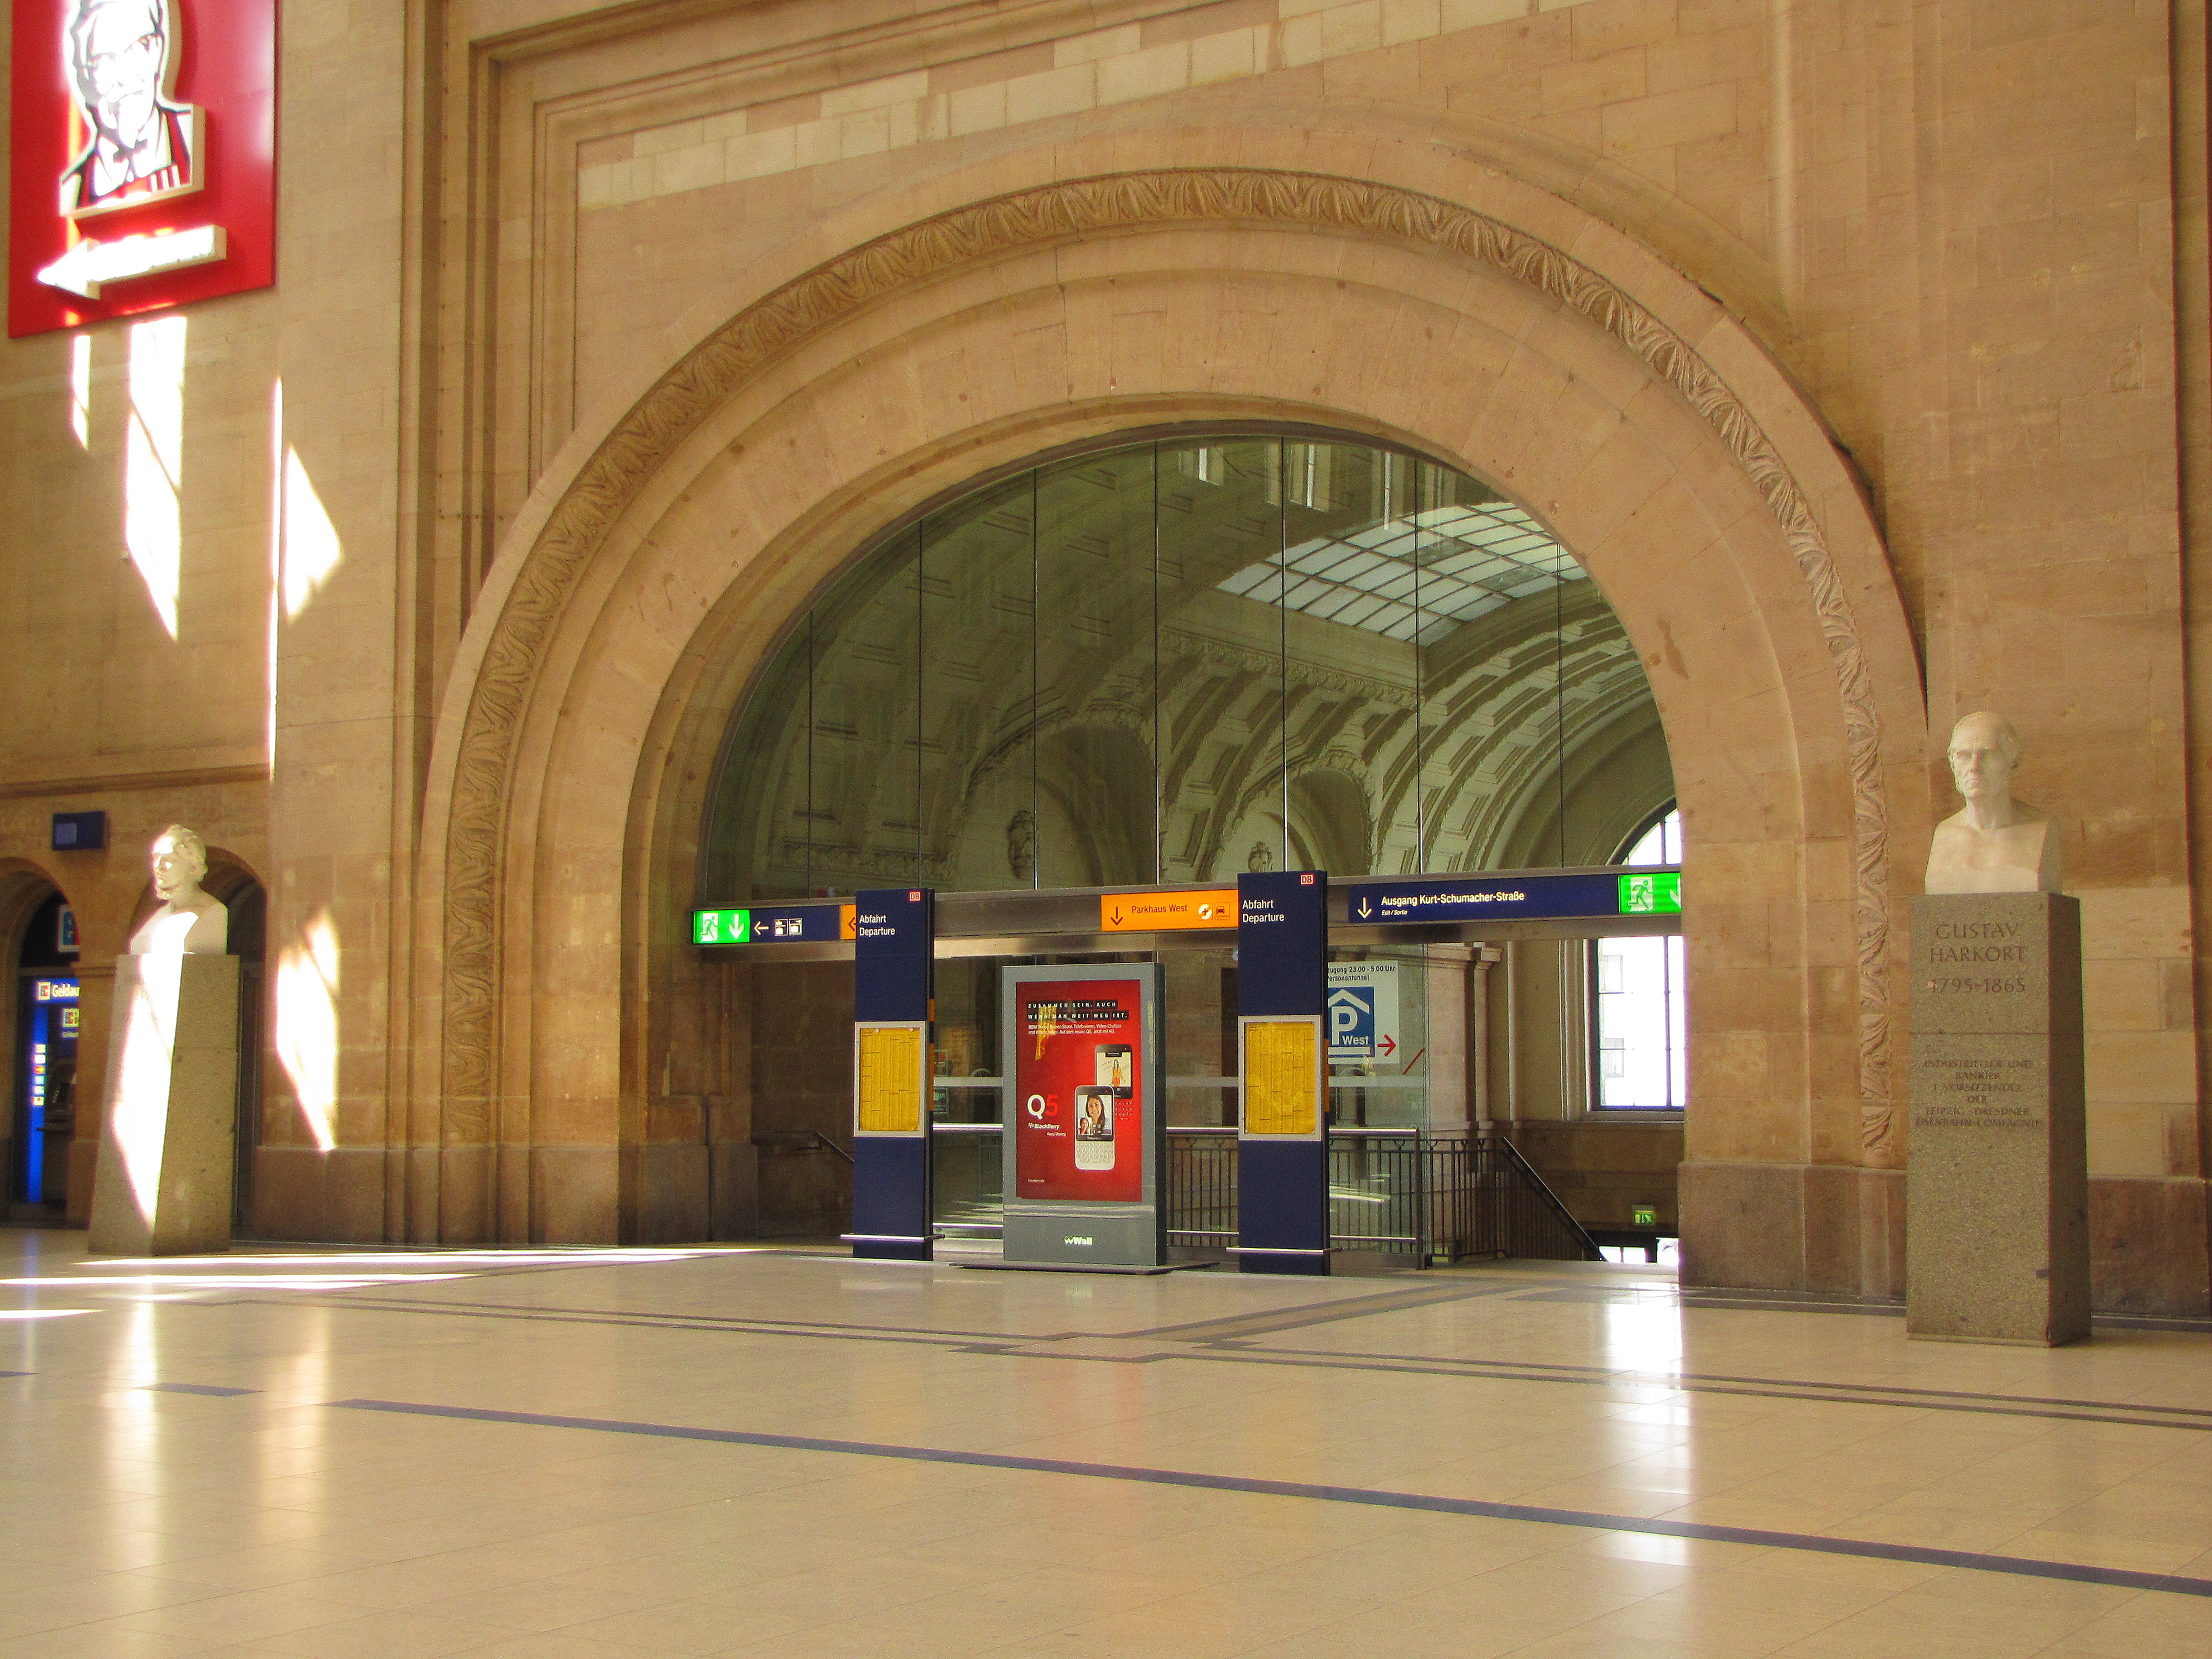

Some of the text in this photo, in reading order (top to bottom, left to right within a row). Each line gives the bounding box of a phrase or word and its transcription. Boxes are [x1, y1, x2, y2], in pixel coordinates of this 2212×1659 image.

[1301, 875, 1313, 884] DB
[1381, 891, 1525, 906] Ausgang Kurt-Schumacher-Straße
[1243, 900, 1274, 909] Abfahrt
[859, 915, 886, 923] Abfahrt
[1243, 914, 1285, 924] Departure
[859, 927, 895, 937] Departure
[1936, 922, 2018, 939] GUSTAV
[1930, 946, 2025, 963] HARKORT
[1332, 1006, 1358, 1045] P
[1342, 1035, 1369, 1045] West
[1967, 1095, 1987, 1104] DER
[1027, 1094, 1058, 1119] Q5
[1073, 1237, 1093, 1245] Wall
